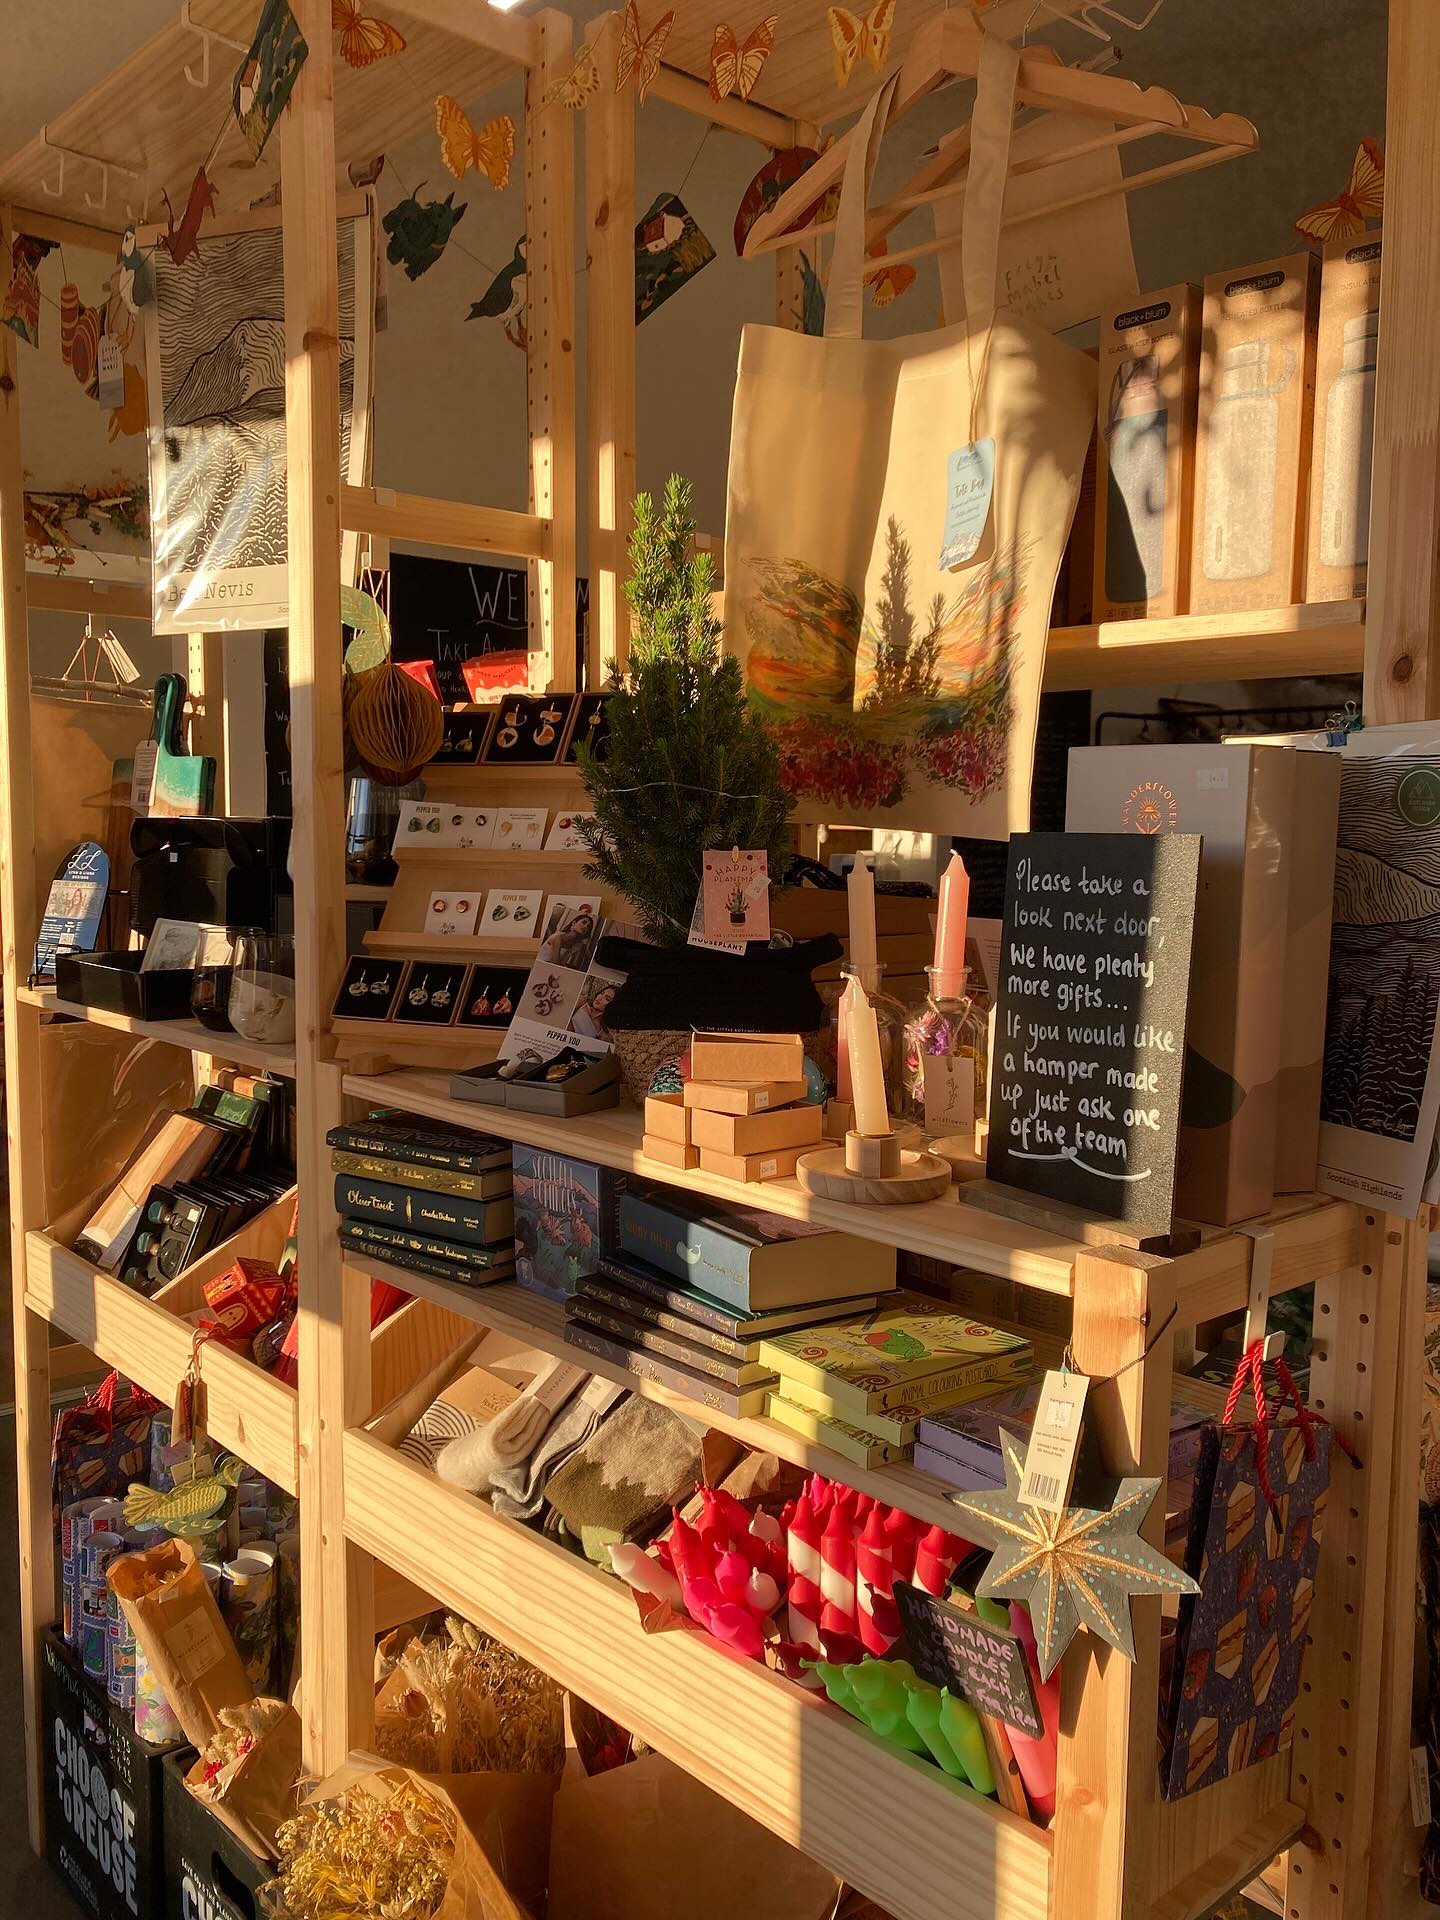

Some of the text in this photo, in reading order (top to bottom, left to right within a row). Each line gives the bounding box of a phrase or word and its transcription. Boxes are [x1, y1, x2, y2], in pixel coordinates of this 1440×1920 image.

[1117, 306, 1167, 328] black+blum
[168, 581, 255, 602] Be Nevis
[715, 864, 757, 877] HAPPY
[1015, 856, 1150, 897] Please take a
[1013, 899, 1054, 929] look
[1063, 907, 1108, 937] next
[1010, 942, 1036, 969] We
[1042, 945, 1088, 974] have
[1094, 952, 1155, 988] plenty
[1007, 974, 1129, 1013] more gifts...
[546, 1030, 567, 1043] PEPPER
[568, 1035, 581, 1047] YOU
[1006, 1009, 1022, 1040] If
[1025, 1022, 1060, 1053] you
[1067, 1023, 1126, 1049] would
[1003, 1051, 1160, 1094] a hamper made
[1001, 1082, 1024, 1111] up
[1077, 1095, 1117, 1122] ask
[1122, 1106, 1162, 1132] one
[1009, 1116, 1129, 1163] of the team
[347, 1189, 395, 1212] Oliver Twist
[1361, 1181, 1403, 1201] Highlands
[421, 1208, 439, 1220] Charles
[438, 1211, 457, 1224] Dickens
[900, 1361, 999, 1402] ANIMAL COLOURING POSTCARDS
[904, 1594, 1014, 1663] HANDMADE
[931, 1632, 1011, 1679] CANDLES
[967, 1666, 1013, 1700] EACH
[73, 1787, 139, 1918] REUSE
